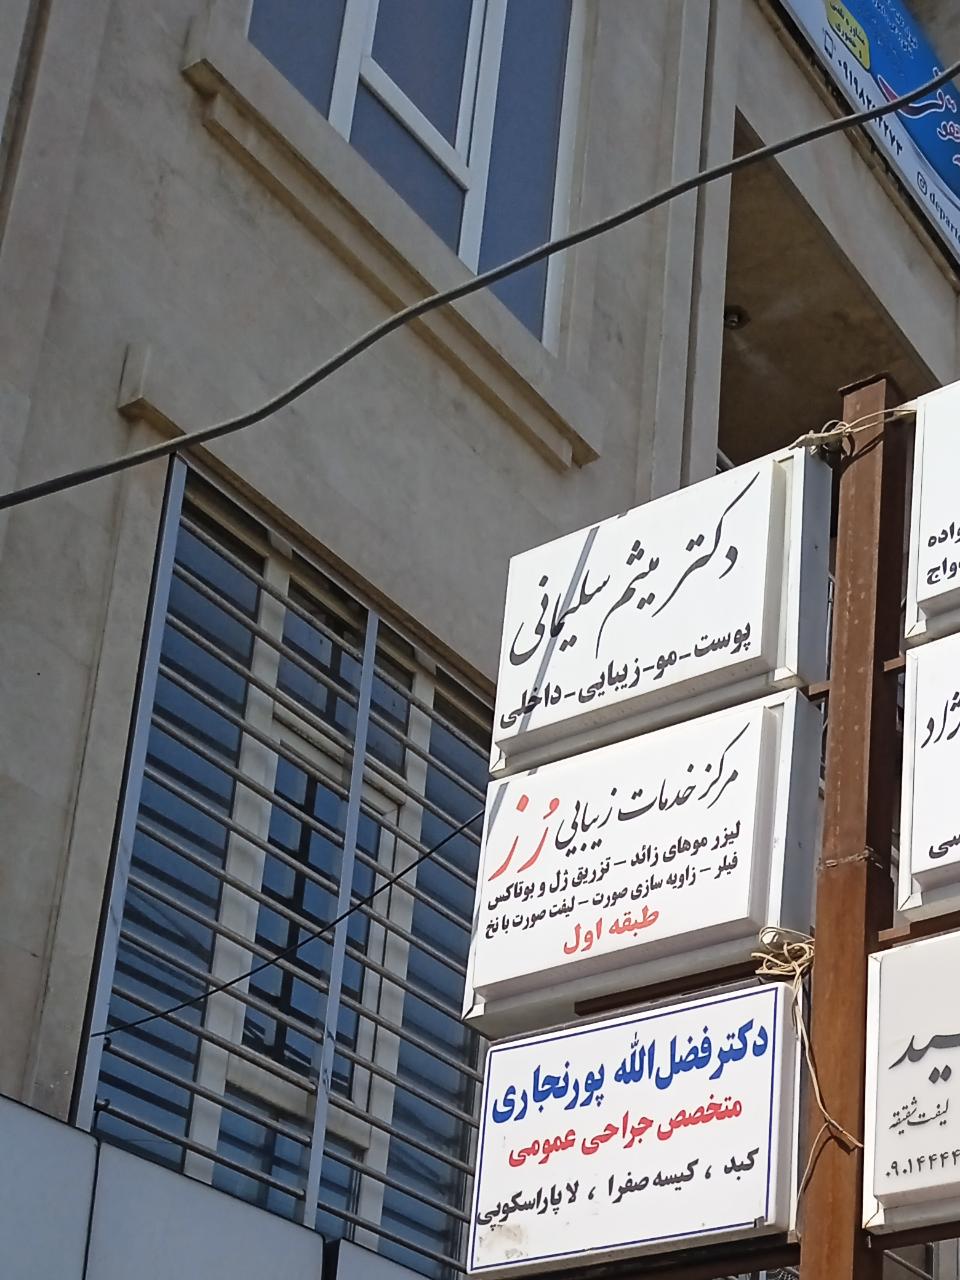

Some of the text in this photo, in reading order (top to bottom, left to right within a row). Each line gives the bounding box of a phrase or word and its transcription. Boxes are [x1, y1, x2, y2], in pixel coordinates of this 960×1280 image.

[509, 471, 760, 667] دکتر میثم سلیمانی
[698, 722, 750, 810] مرکز
[617, 763, 697, 823] خدمات
[554, 787, 618, 858] زیبایی
[487, 820, 742, 911] لیزر موهای زائد تزریق ژل و بوتاکس
[666, 862, 697, 890] زاویه
[714, 851, 739, 879] فیلر
[592, 885, 629, 909] صورت
[630, 872, 664, 900] سازی
[512, 907, 547, 930] صورت
[548, 896, 576, 921] لیفت
[562, 905, 661, 955] طبقه اول
[492, 1061, 605, 1124] پورنجاری
[508, 1094, 743, 1168] متخصص جراحی عمومی
[652, 1159, 700, 1193] کیسه
[723, 1148, 760, 1181] کبد
[607, 1171, 650, 1205] صفرا
